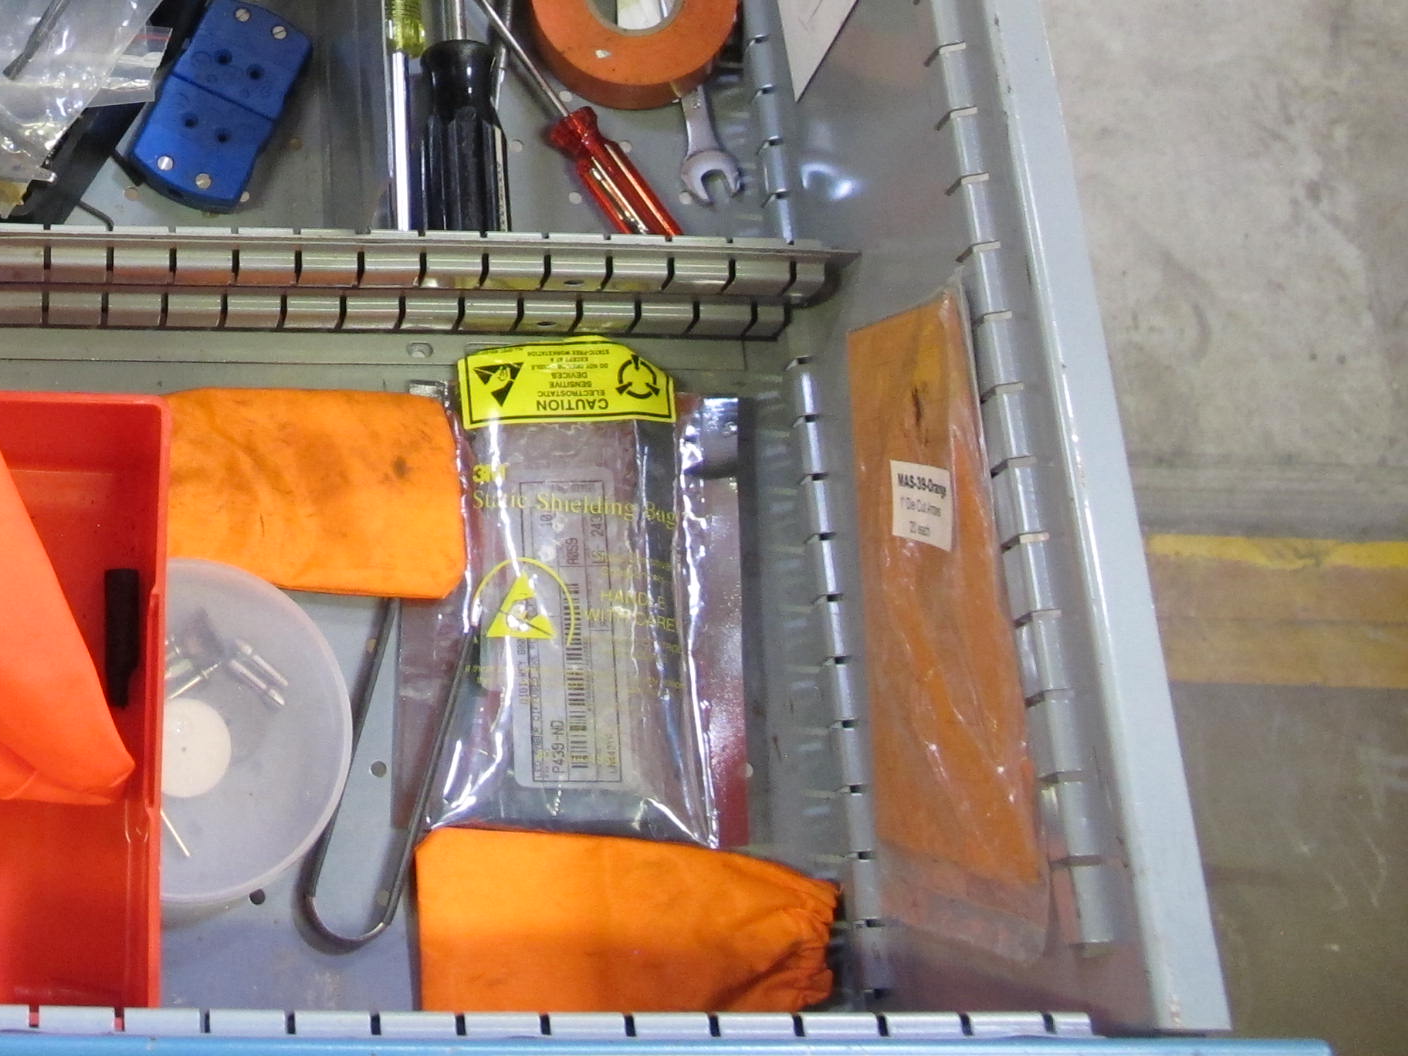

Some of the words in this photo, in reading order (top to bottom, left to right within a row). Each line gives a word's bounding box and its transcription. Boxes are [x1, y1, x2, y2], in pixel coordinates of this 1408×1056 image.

[551, 371, 588, 379] DEVICES
[549, 380, 592, 388] SENSITIVE
[537, 389, 605, 397] ELECTROSTATIC
[536, 398, 609, 411] CAUTION
[536, 493, 636, 521] Shielding
[645, 504, 677, 530] Bag
[600, 589, 665, 610] HANDE
[550, 719, 565, 774] P439-ND
